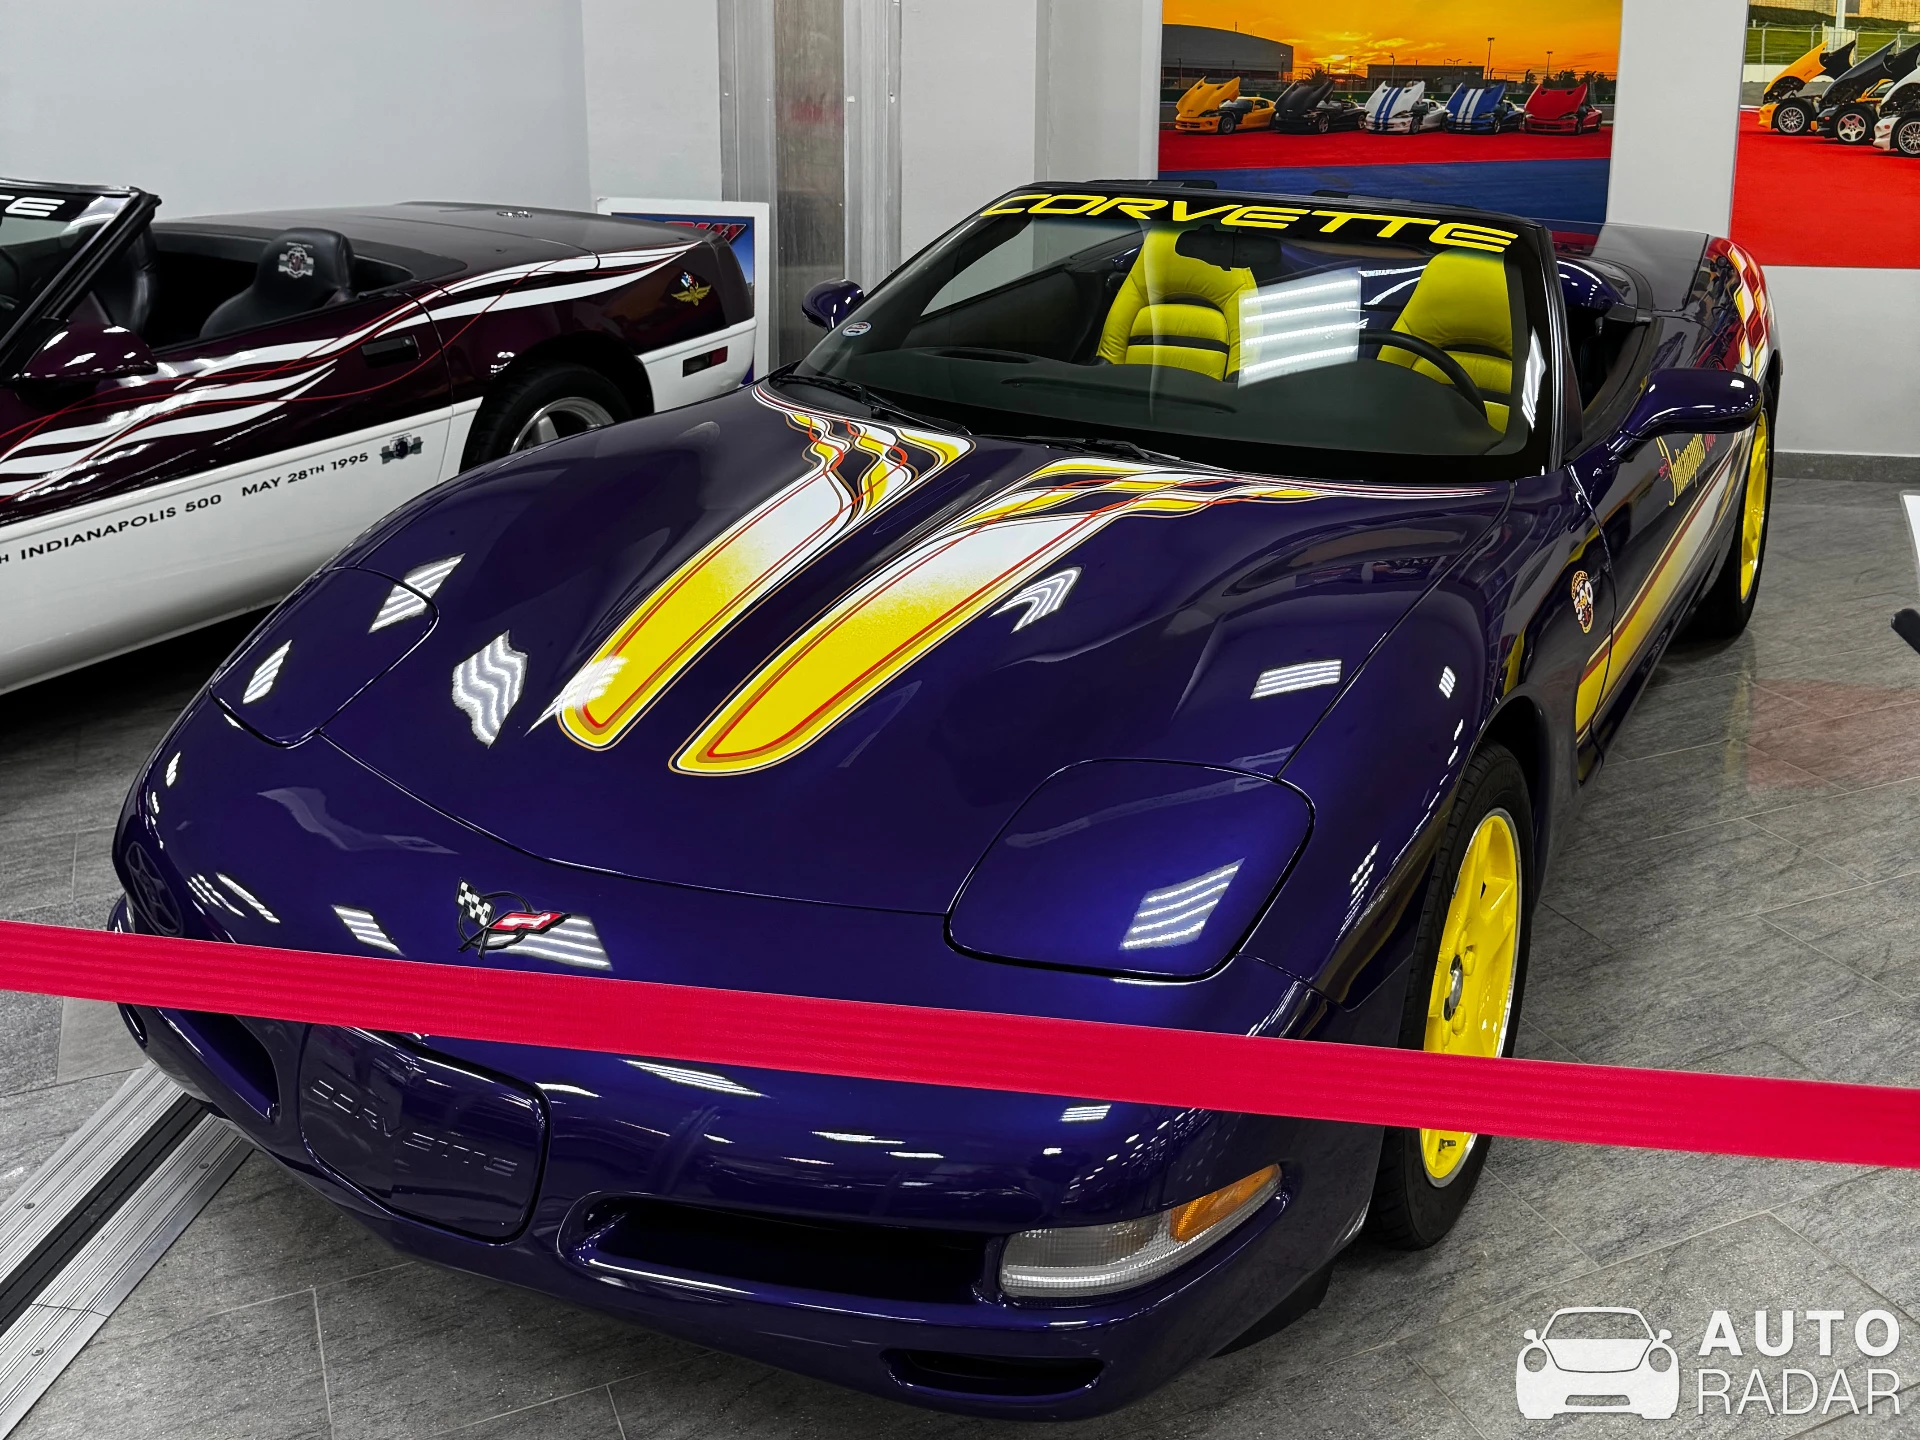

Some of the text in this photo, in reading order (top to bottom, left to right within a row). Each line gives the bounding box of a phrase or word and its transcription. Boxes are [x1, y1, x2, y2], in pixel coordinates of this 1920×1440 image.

[980, 193, 1519, 253] CORVETTE
[20, 506, 177, 560] INDIANAPOLIS
[185, 494, 222, 513] 500
[241, 476, 281, 497] MAY
[287, 464, 325, 484] 28TH
[331, 452, 369, 471] 1995
[309, 1079, 518, 1177] CORVETTE
